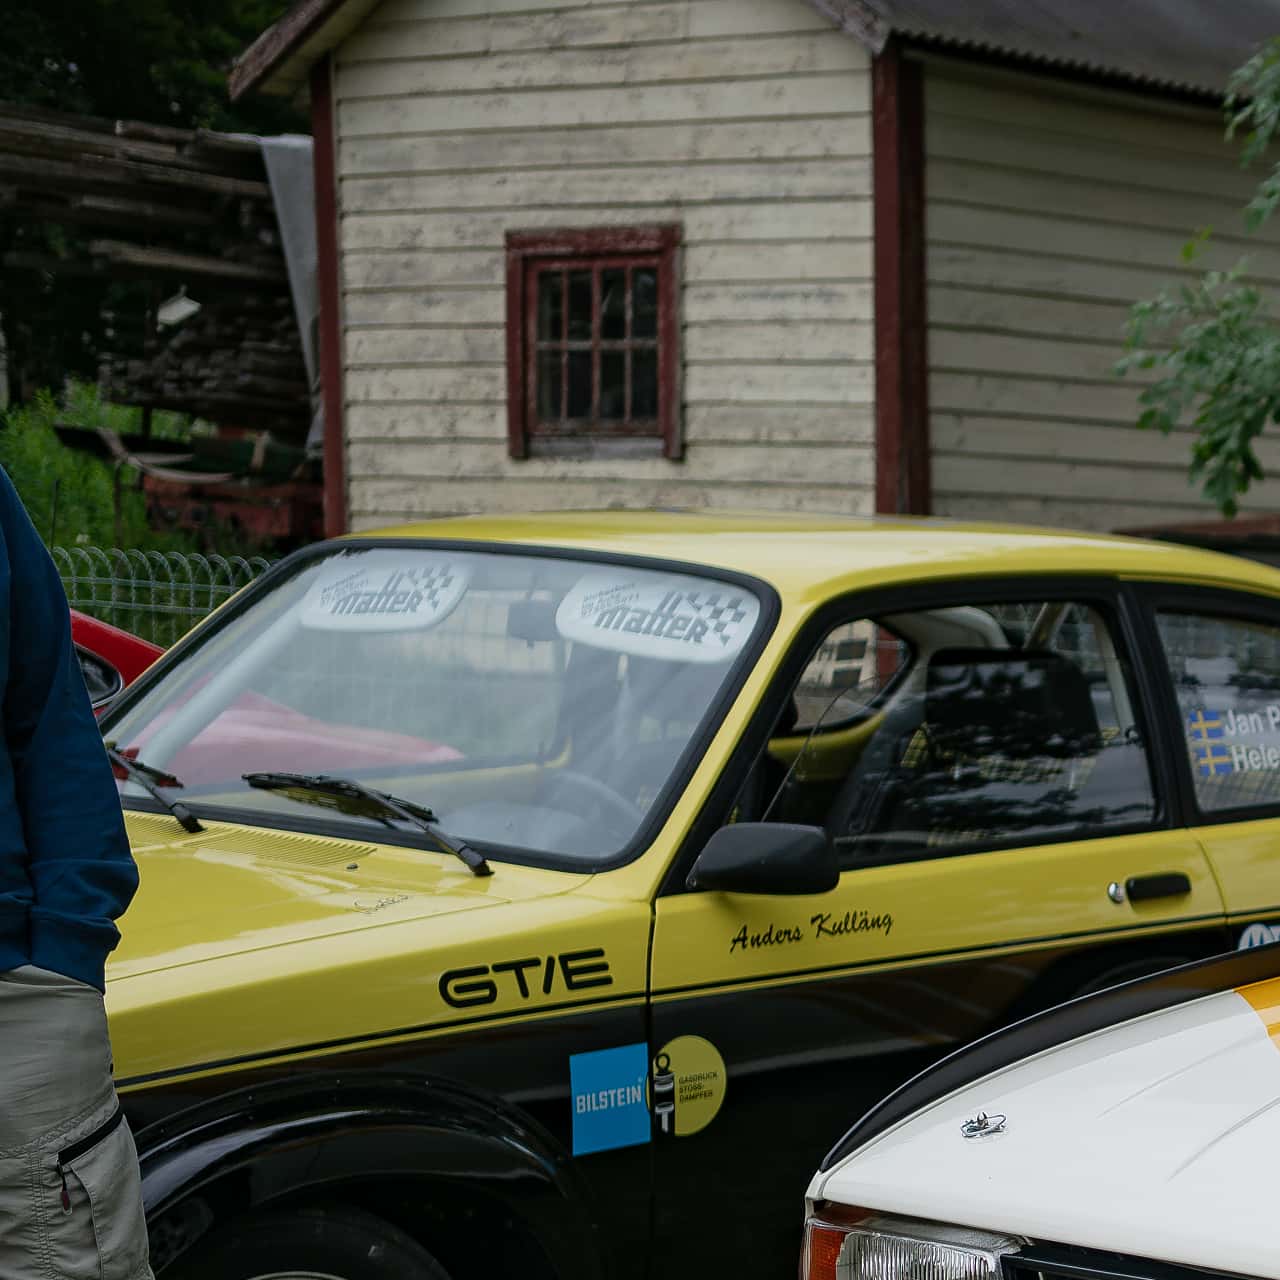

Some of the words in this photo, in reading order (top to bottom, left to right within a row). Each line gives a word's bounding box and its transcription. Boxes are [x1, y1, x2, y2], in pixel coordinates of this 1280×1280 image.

[1225, 709, 1264, 736] Jan
[729, 924, 802, 953] Anders
[809, 911, 894, 941] Kulläng
[438, 947, 614, 1009] GT/E
[576, 1085, 642, 1114] BILSTEIN
